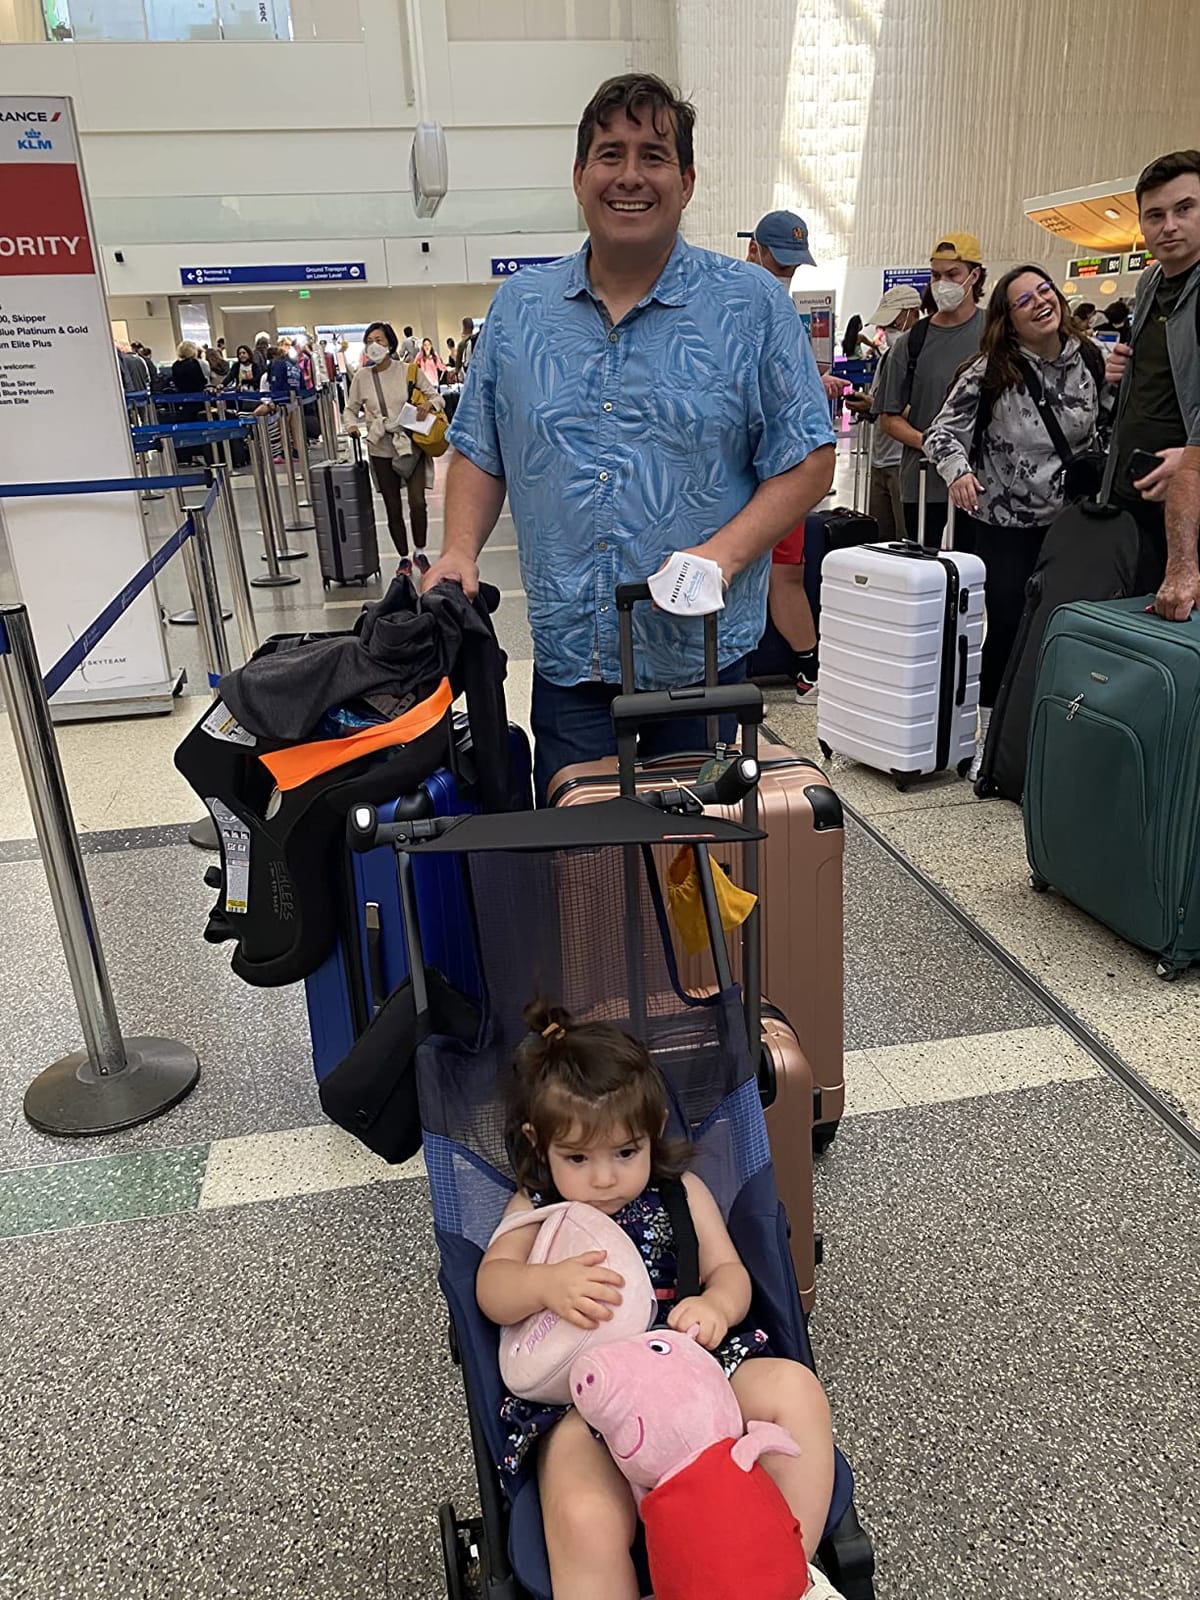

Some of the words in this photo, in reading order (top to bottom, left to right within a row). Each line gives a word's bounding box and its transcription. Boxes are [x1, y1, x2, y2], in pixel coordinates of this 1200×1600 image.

[17, 139, 53, 149] KLM
[12, 314, 46, 323] Skipper
[17, 326, 57, 336] Platinum
[58, 326, 66, 334] &
[67, 326, 89, 334] Gold
[11, 340, 31, 349] Elite
[32, 339, 53, 348] Plus
[19, 387, 55, 396] Petroleum
[87, 657, 127, 666] SKYTEAM
